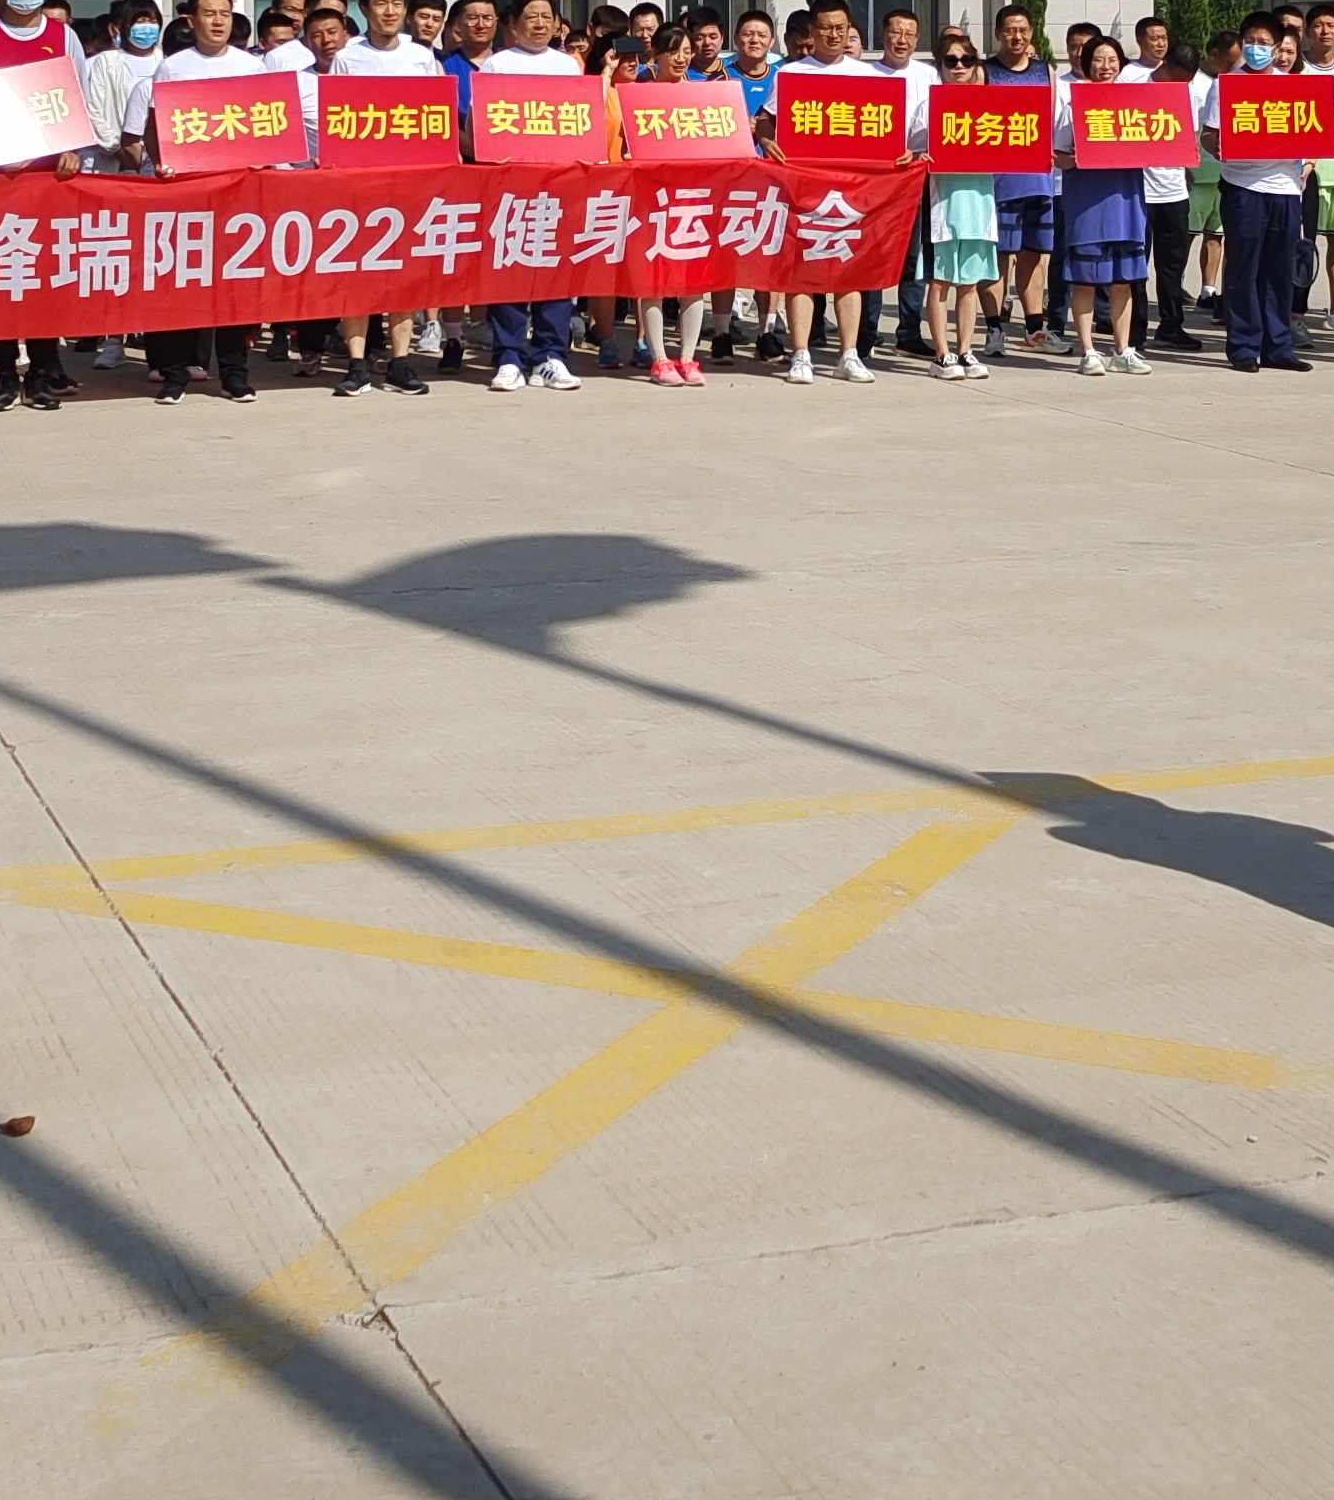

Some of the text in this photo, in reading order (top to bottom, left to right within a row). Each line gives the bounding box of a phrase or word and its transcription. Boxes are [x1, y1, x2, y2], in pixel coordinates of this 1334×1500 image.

[171, 100, 289, 145] 技术部
[326, 103, 452, 140] 动力车间
[486, 100, 591, 137] 安监部
[633, 106, 738, 140] 环保部
[790, 100, 894, 138] 销售部
[941, 111, 1039, 147] 财务部
[1084, 107, 1182, 143] 董监办
[1230, 100, 1324, 135] 高管队
